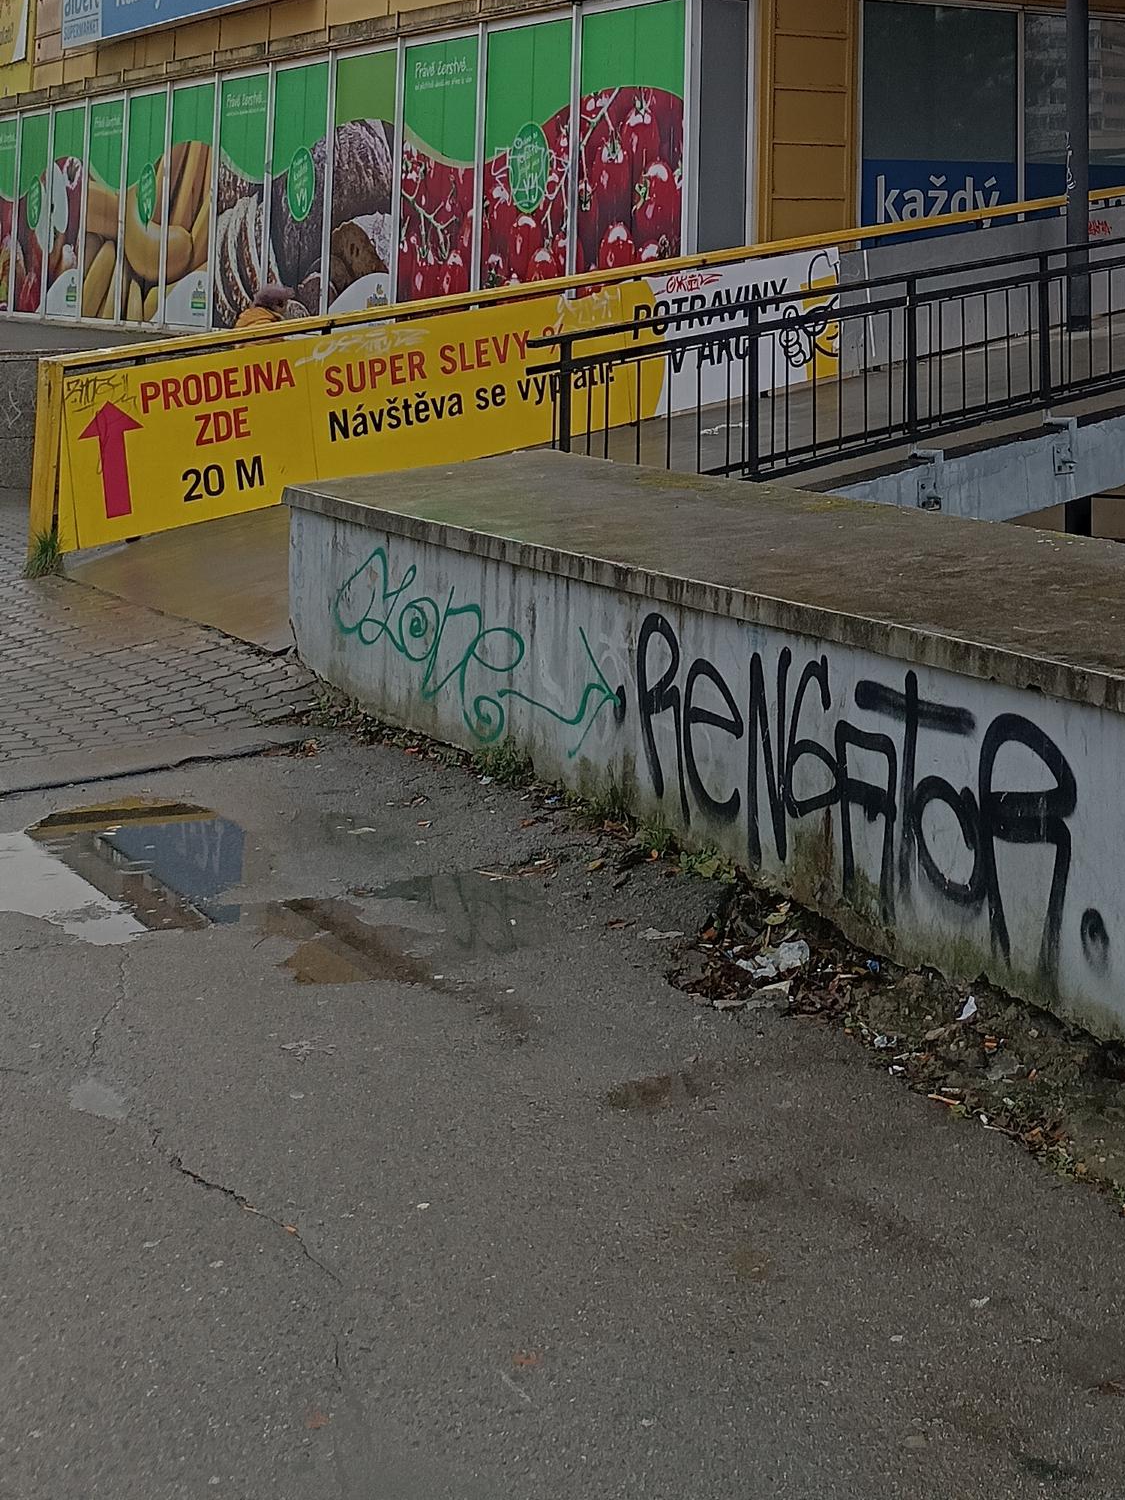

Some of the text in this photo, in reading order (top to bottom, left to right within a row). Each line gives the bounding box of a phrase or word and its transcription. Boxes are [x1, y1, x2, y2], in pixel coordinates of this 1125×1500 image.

[64, 19, 99, 40] SUPERMARKET
[632, 278, 788, 340] POTRAVINY
[140, 358, 295, 414] PRODEJNA
[324, 350, 426, 397] SUPER
[440, 330, 530, 375] SLEVY
[194, 406, 251, 447] ZDE
[328, 391, 463, 441] Návštěva
[475, 384, 506, 410] se
[182, 455, 265, 502] 20 M
